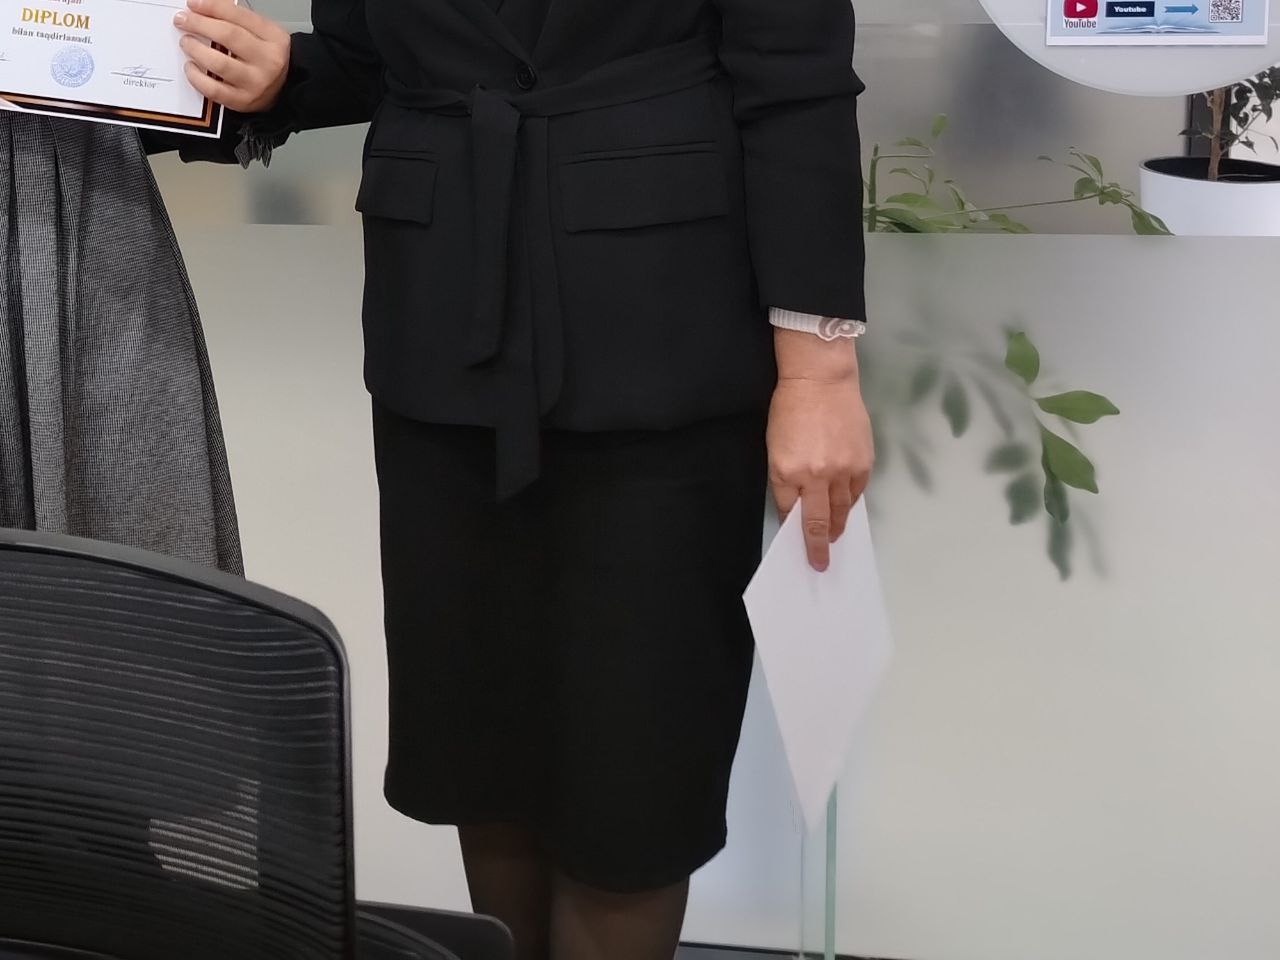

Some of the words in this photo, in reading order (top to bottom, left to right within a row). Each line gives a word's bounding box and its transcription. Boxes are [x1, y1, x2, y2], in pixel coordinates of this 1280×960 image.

[1113, 5, 1148, 14] Youtube
[21, 6, 90, 30] DIPLOM
[1064, 18, 1097, 29] YouTube
[12, 26, 34, 37] bilan
[36, 29, 93, 46] taqdirlanadi.
[123, 77, 157, 89] direktor
